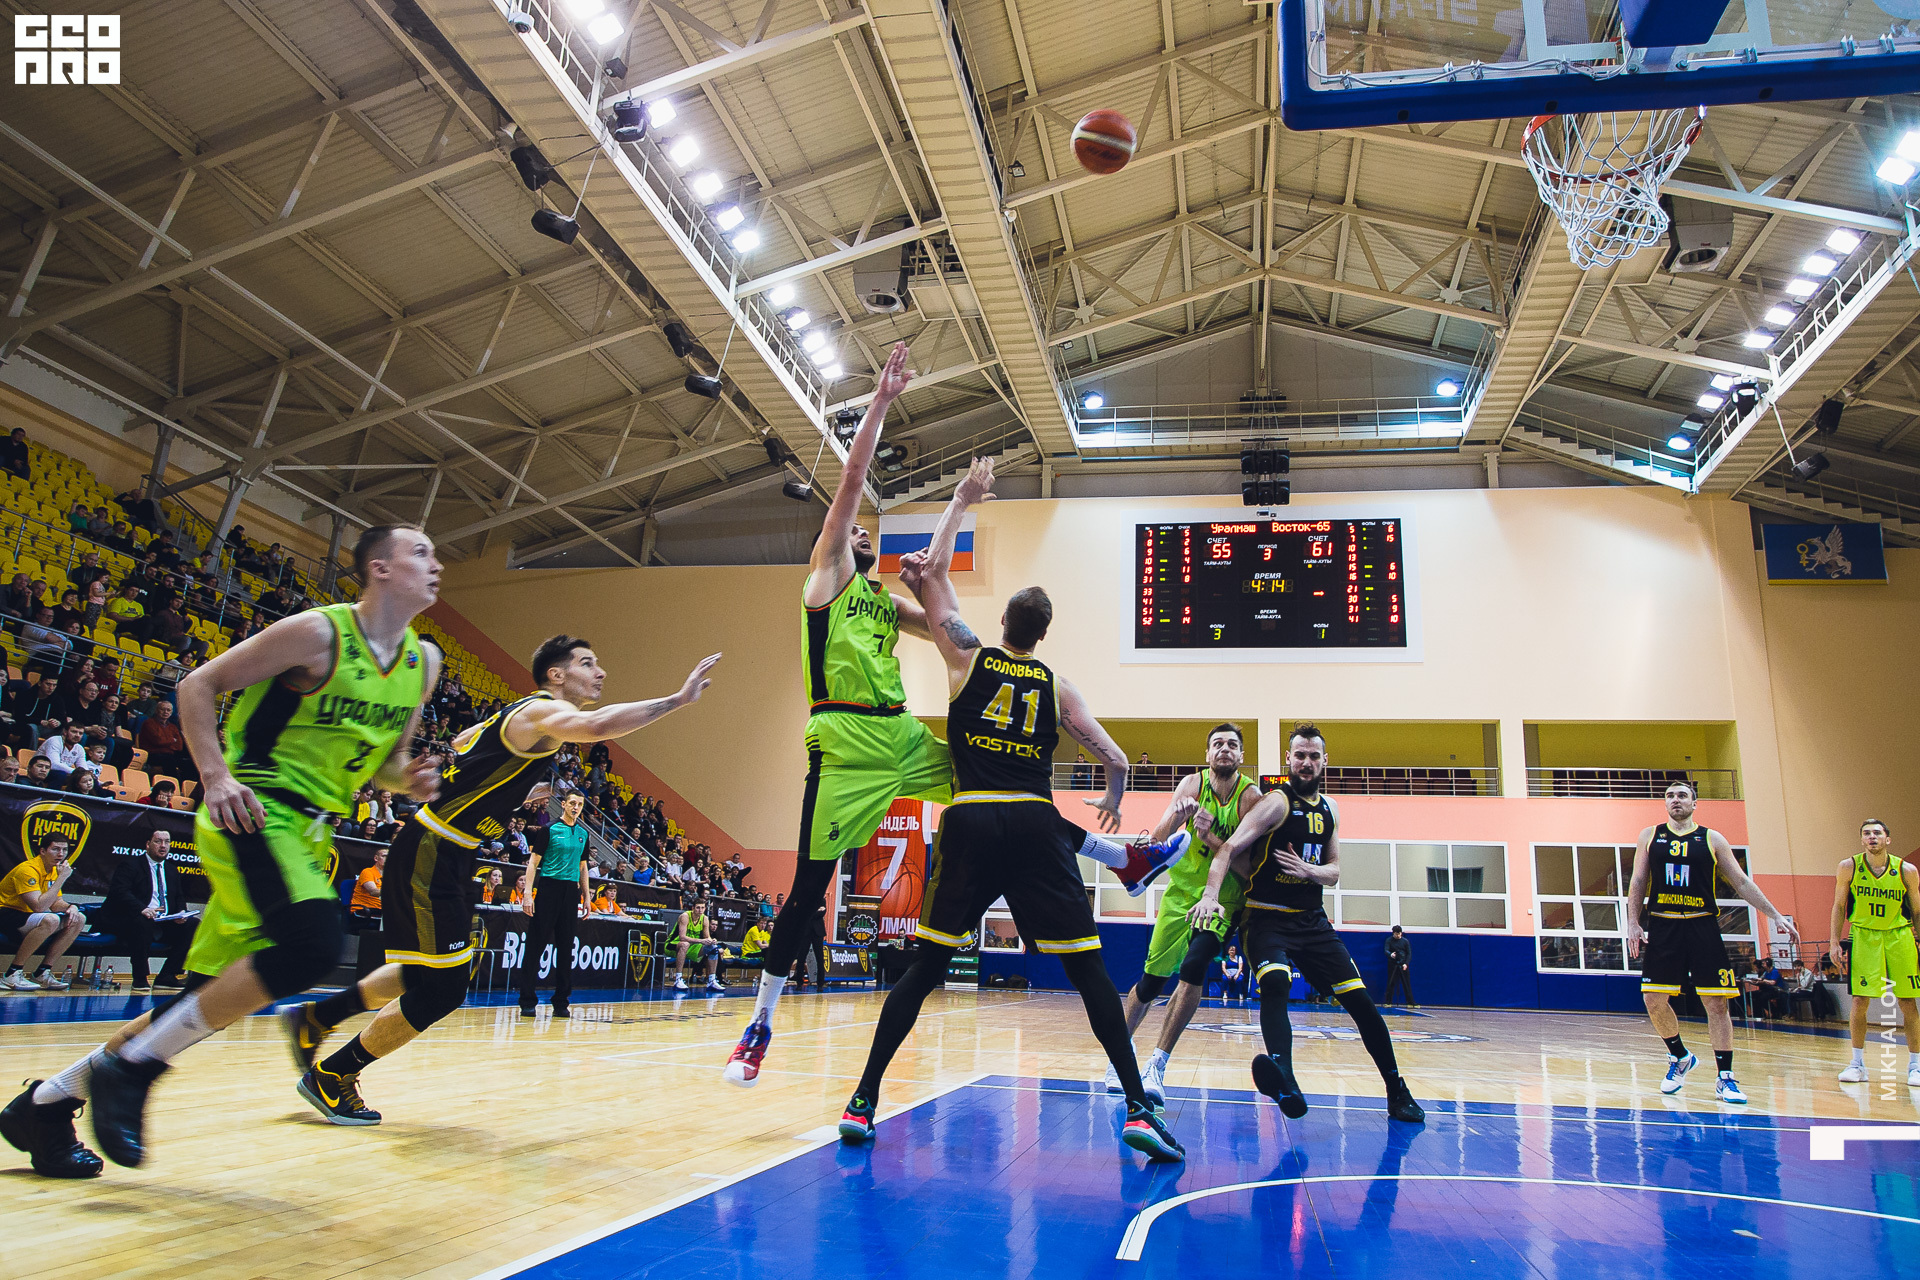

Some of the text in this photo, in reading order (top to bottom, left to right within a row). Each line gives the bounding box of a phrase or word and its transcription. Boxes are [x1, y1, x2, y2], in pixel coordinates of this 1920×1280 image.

[1210, 523, 1257, 534] Уралмаш
[1271, 521, 1332, 533] Восток-65
[1350, 526, 1355, 534] 5
[1388, 524, 1394, 532] 6
[1148, 530, 1153, 538] 7
[1184, 529, 1190, 537] 5
[1146, 538, 1153, 547] 8
[1184, 538, 1190, 546] 2
[1350, 534, 1356, 543] 7
[1386, 534, 1394, 542] 15
[1147, 548, 1153, 556] 9
[1184, 547, 1190, 556] 6
[1212, 543, 1231, 558] 55
[1312, 541, 1333, 558] 61
[1348, 544, 1356, 552] 10
[1264, 548, 1272, 560] 3
[1348, 553, 1356, 562] 13
[1144, 557, 1153, 566] 10
[1390, 562, 1396, 570] 6
[1144, 566, 1153, 574] 19
[1348, 562, 1356, 571] 15
[1142, 576, 1153, 584] 31
[1184, 574, 1190, 583] 8
[1349, 572, 1357, 580] 16
[1388, 572, 1396, 580] 10
[1251, 580, 1286, 593] 4:14
[1347, 584, 1358, 593] 21
[1142, 588, 1153, 596] 33
[1142, 597, 1153, 605] 41
[1348, 594, 1358, 603] 30
[1392, 594, 1398, 602] 5
[1142, 607, 1153, 616] 51
[1184, 606, 1190, 614] 5
[1348, 604, 1358, 613] 31
[1392, 604, 1398, 612] 9
[1142, 616, 1153, 626] 52
[1182, 616, 1190, 624] 14
[1348, 615, 1359, 623] 41
[1390, 614, 1398, 623] 10
[1213, 628, 1222, 640] 3
[1321, 628, 1326, 639] 1
[873, 633, 886, 654] 7
[980, 682, 1041, 738] 41
[965, 732, 1043, 760] VOSTOK
[879, 815, 920, 832] АНДЕЛЬ
[1306, 811, 1324, 835] 16
[111, 845, 130, 856] XIX
[1669, 840, 1689, 857] 31
[877, 837, 908, 890] 7
[1868, 902, 1886, 917] 10
[1718, 968, 1737, 987] 31
